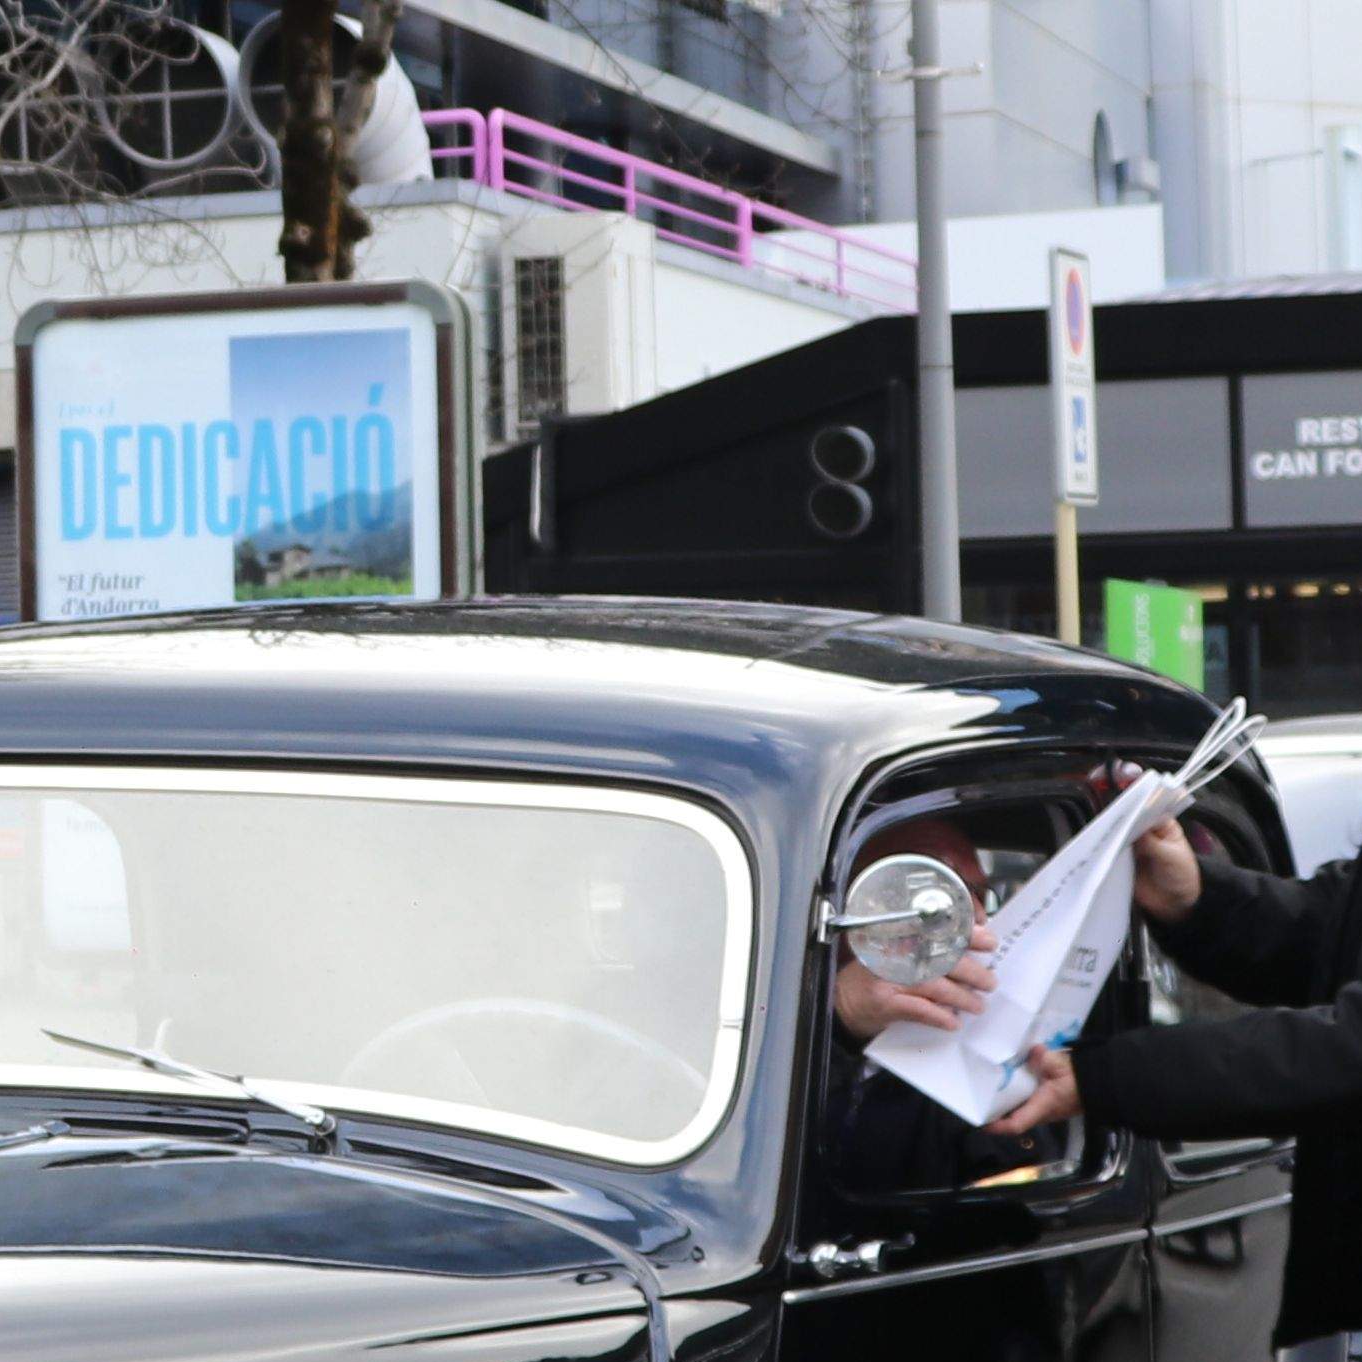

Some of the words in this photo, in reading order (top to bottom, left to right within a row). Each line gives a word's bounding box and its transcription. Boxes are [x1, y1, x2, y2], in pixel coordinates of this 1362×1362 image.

[59, 382, 396, 541] DEDICACIÓ
[1253, 451, 1318, 480] CAN
[87, 573, 145, 596] futur
